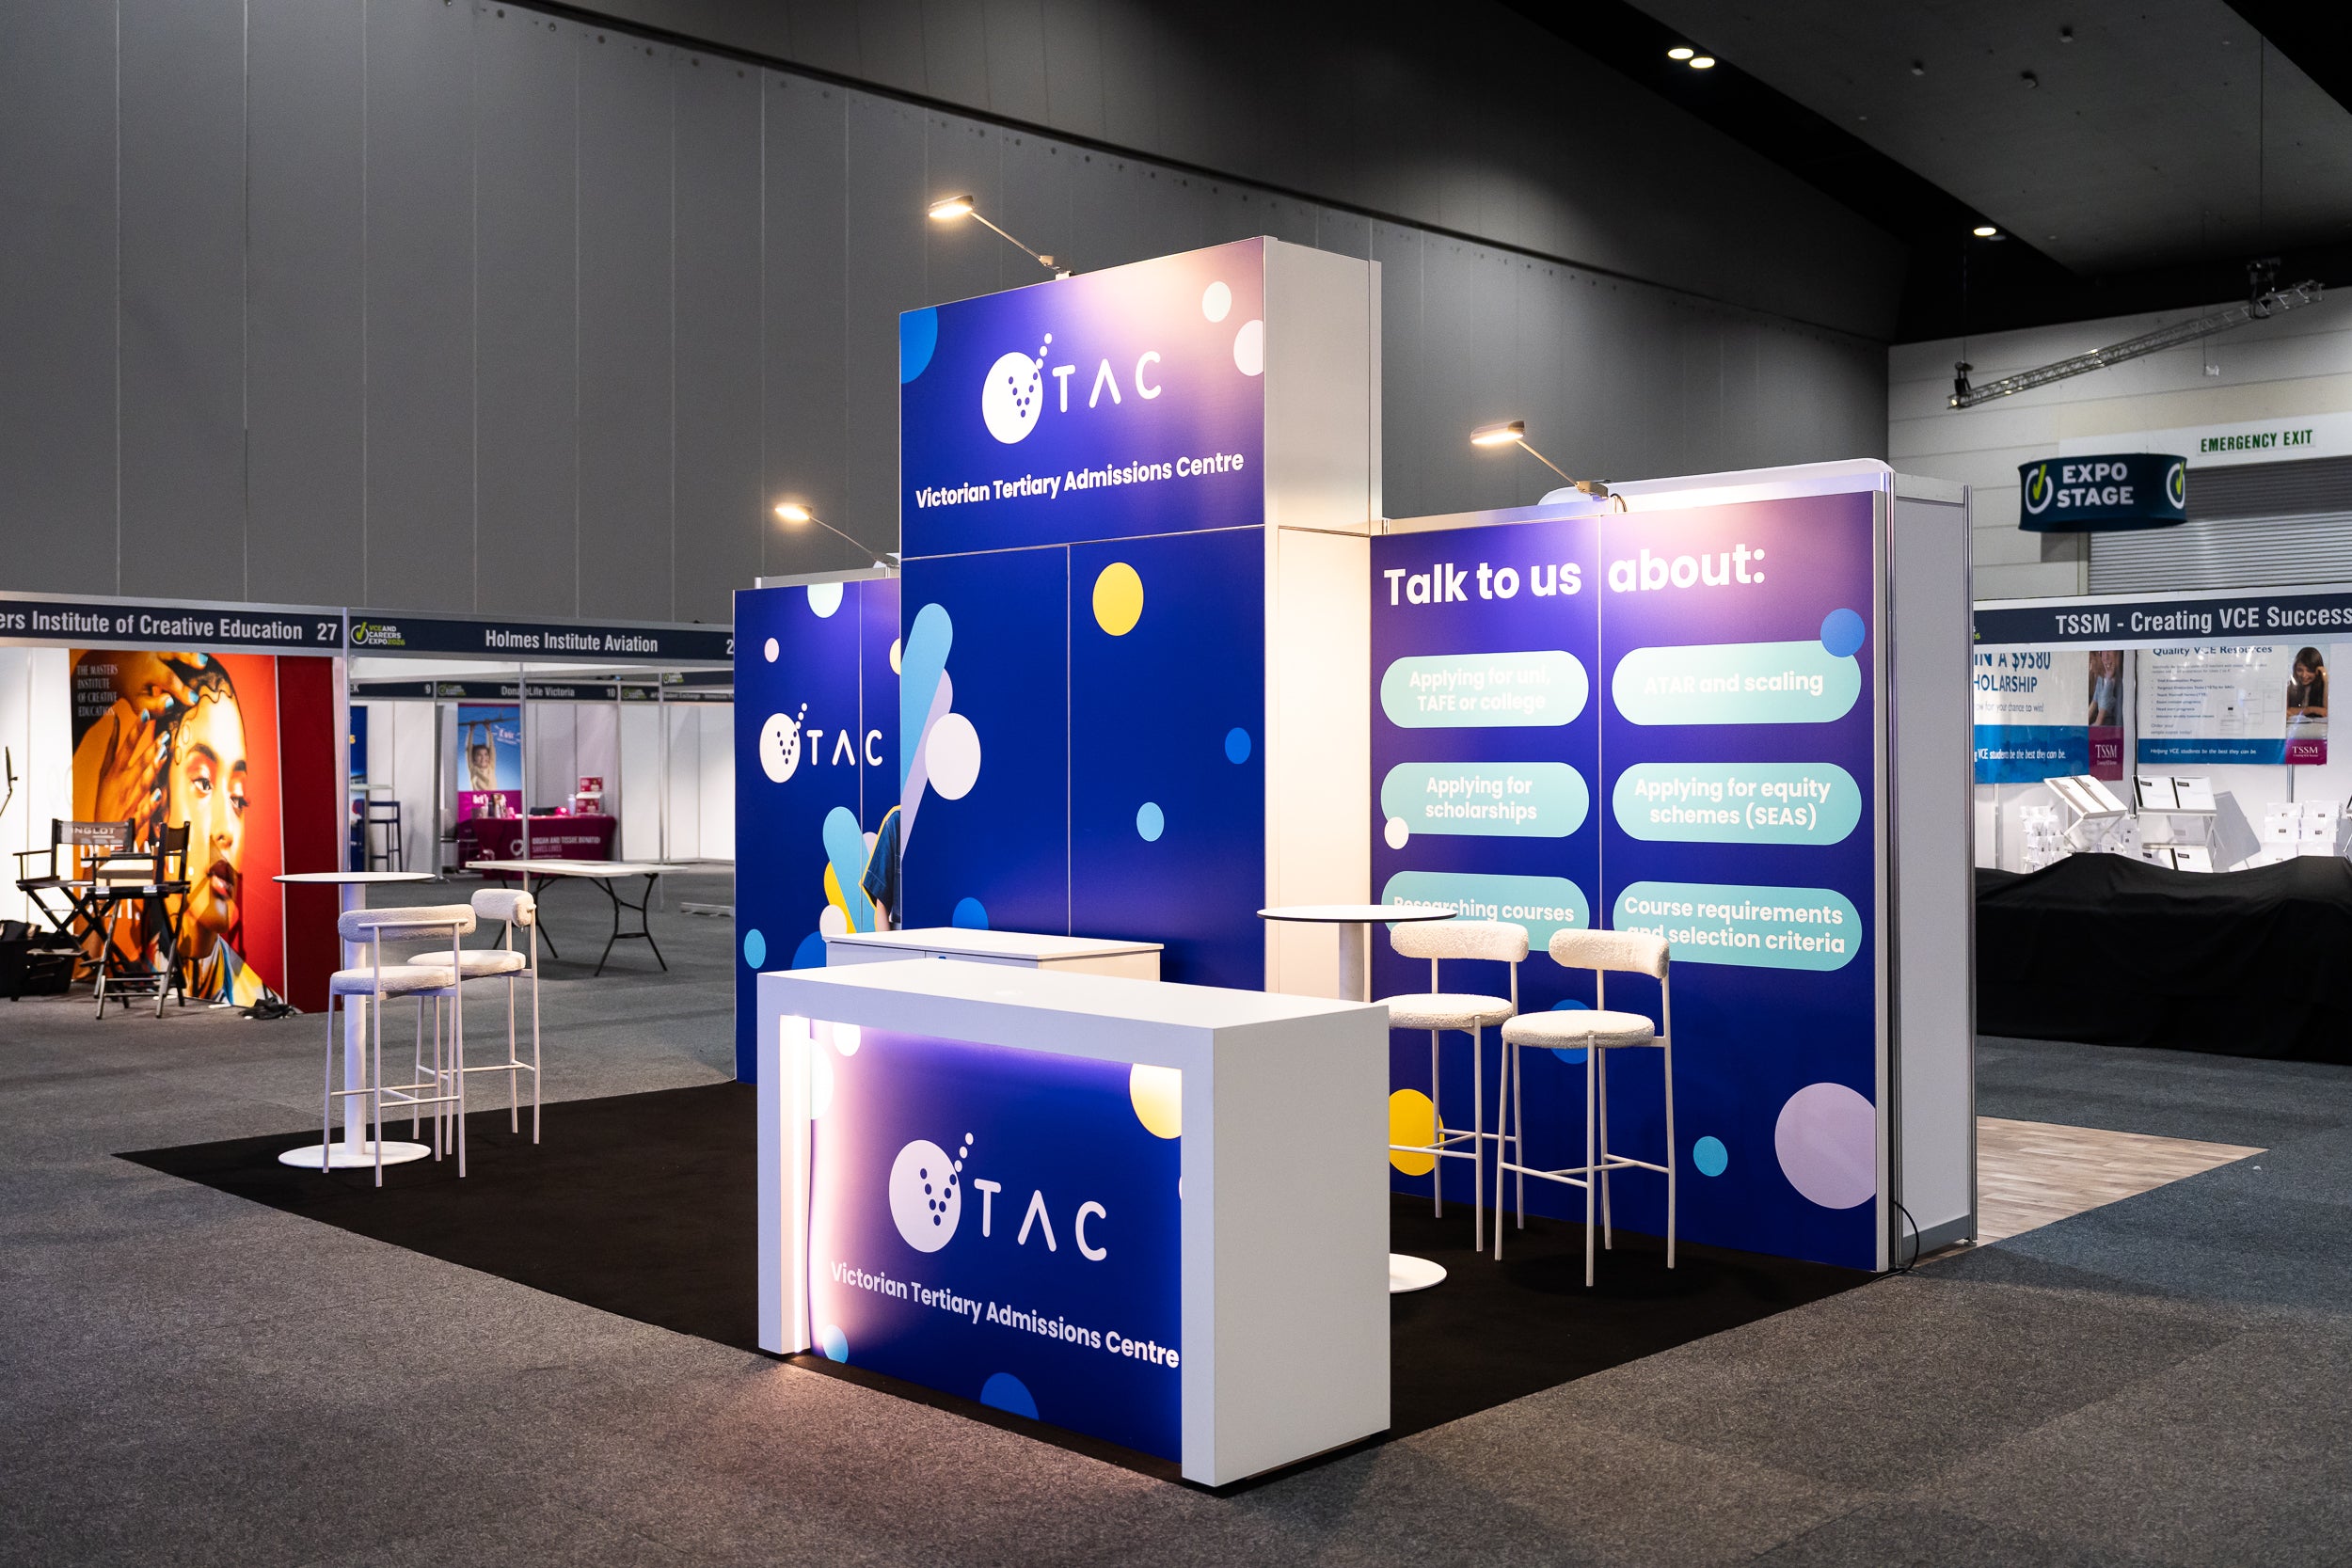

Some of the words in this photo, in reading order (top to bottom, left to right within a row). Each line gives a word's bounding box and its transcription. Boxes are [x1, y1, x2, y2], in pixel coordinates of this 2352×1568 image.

[2201, 433, 2277, 452] EMERGENCY
[2283, 430, 2313, 446] EXIT
[915, 483, 991, 509] Victorian
[993, 474, 1061, 499] Tertiary
[1064, 461, 1172, 492] Admissions
[1176, 451, 1244, 477] Centre
[2062, 462, 2128, 484] EXPO
[2057, 485, 2134, 509] STAGE
[1384, 562, 1469, 606] Talk
[1476, 562, 1520, 600] to
[1531, 562, 1582, 597] us
[1608, 544, 1766, 594] about:
[32, 610, 110, 633] Institute
[116, 614, 135, 634] of
[140, 614, 215, 637] Creative
[220, 618, 303, 641] Education
[317, 623, 338, 641] 27
[2056, 613, 2110, 635] TSSM
[2131, 610, 2212, 633] Creating
[2219, 608, 2260, 629] VCE
[2266, 606, 2352, 627] Success
[485, 629, 540, 649] Holmes
[544, 630, 600, 651] Institute
[604, 633, 659, 653] Aviation
[424, 684, 431, 694] 9
[1408, 668, 1485, 692] Applying
[1488, 666, 1513, 686] for
[1644, 676, 1694, 695] ATAR
[1700, 673, 1740, 693] and
[1744, 671, 1823, 696] scaling
[501, 686, 543, 697] DonaeLife
[545, 688, 576, 697] Victoria
[606, 689, 616, 698] 10
[1417, 695, 1455, 712] TAFE
[1459, 697, 1476, 711] or
[1481, 693, 1547, 715] college
[2292, 746, 2318, 754] TSSM
[1426, 776, 1502, 799] Applying
[1506, 776, 1533, 795] for
[1634, 778, 1723, 802] Applying
[1727, 778, 1757, 797] for
[1760, 777, 1832, 804] equity
[1424, 801, 1538, 825] scholarships
[1649, 805, 1740, 825] schemes
[1745, 802, 1817, 831] (SEAS)
[1502, 904, 1575, 922] courses
[1624, 896, 1693, 917] Course
[1697, 900, 1844, 925] requirements
[1669, 926, 1760, 948] selection
[1765, 930, 1845, 953] criteria
[831, 1261, 908, 1300] Victorian
[911, 1282, 982, 1323] Tertiary
[986, 1301, 1101, 1349] Admissions
[1105, 1330, 1179, 1368] Centre
